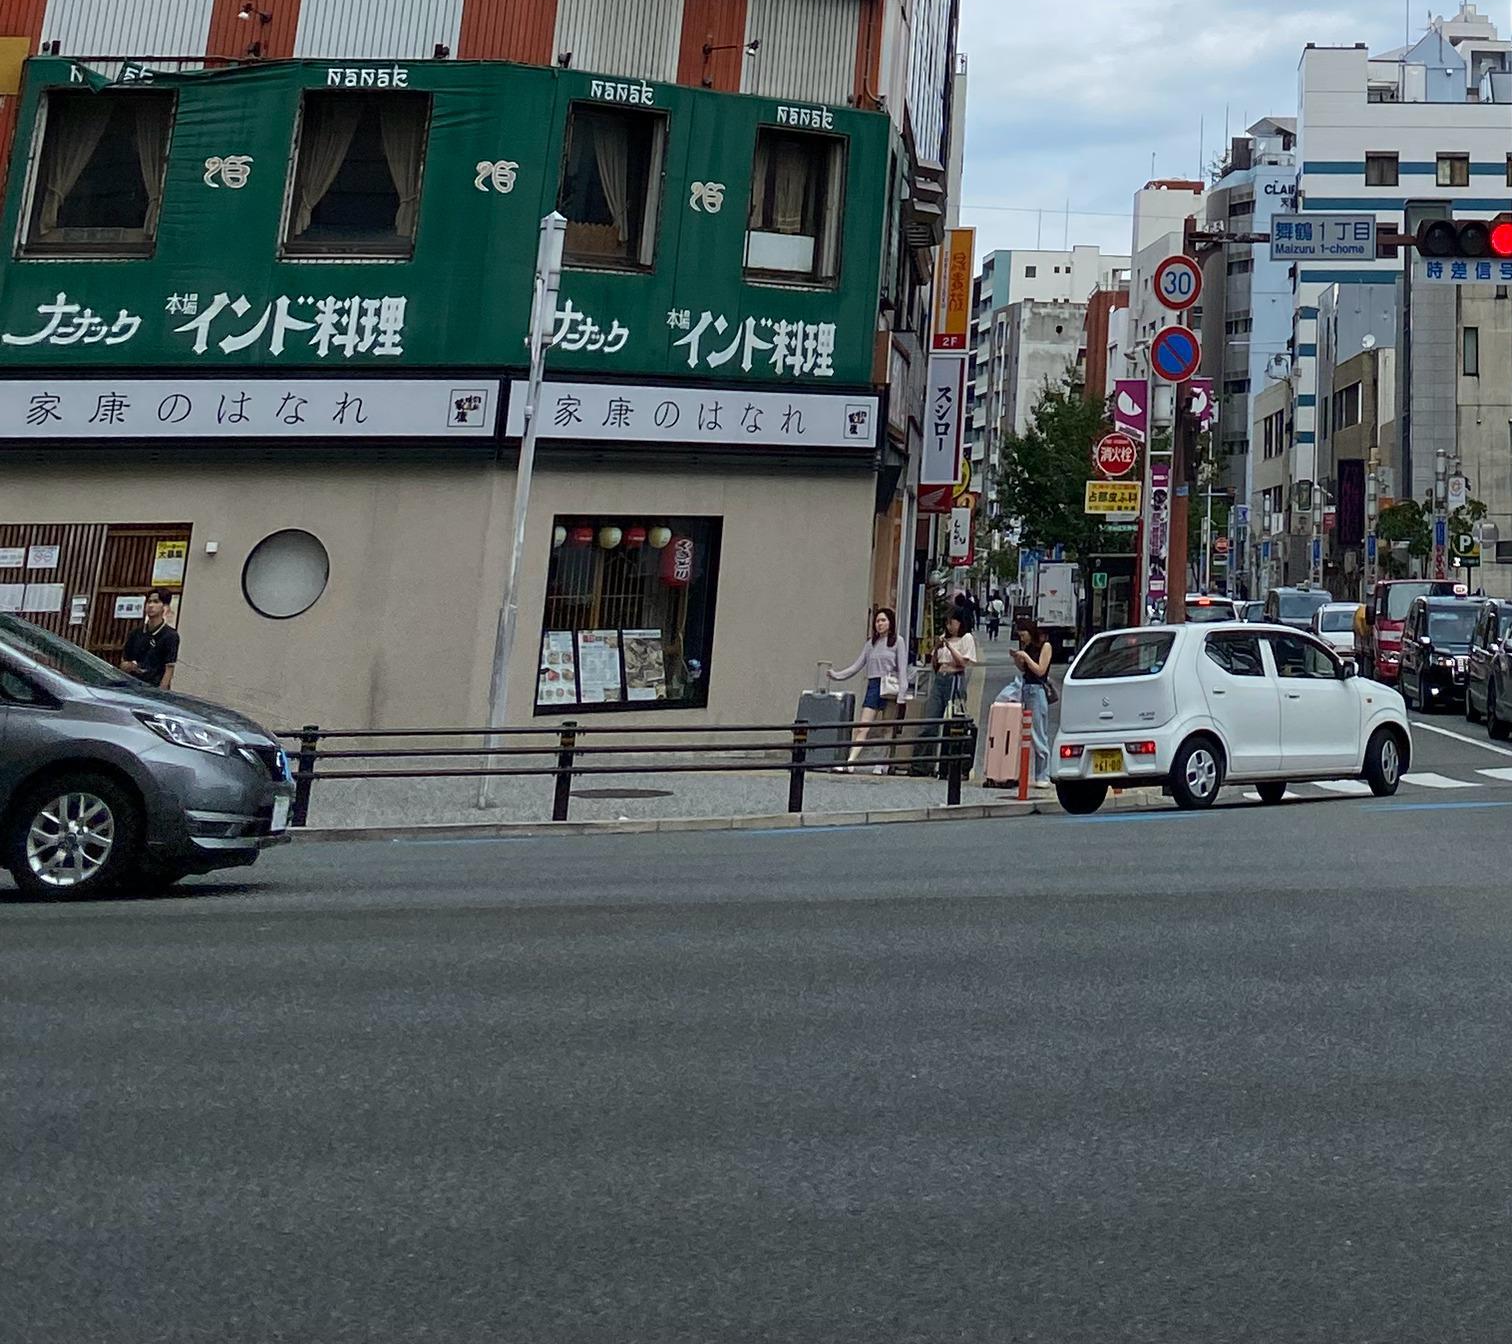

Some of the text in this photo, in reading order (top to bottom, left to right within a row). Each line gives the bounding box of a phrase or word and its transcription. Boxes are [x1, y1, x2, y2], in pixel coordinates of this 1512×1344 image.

[1275, 221, 1370, 243] 舞鶴1丁目
[1275, 243, 1365, 255] Maizuru 1-chome
[1163, 269, 1193, 296] 30
[174, 291, 408, 358] インド料理
[673, 310, 838, 378] インド料理
[942, 336, 958, 347] 2F
[26, 391, 368, 425] 家康のはなれ
[553, 393, 807, 435] 家康のはなれ
[934, 387, 952, 451] スシロー
[1100, 446, 1131, 463] 消火栓
[1460, 536, 1471, 551] P
